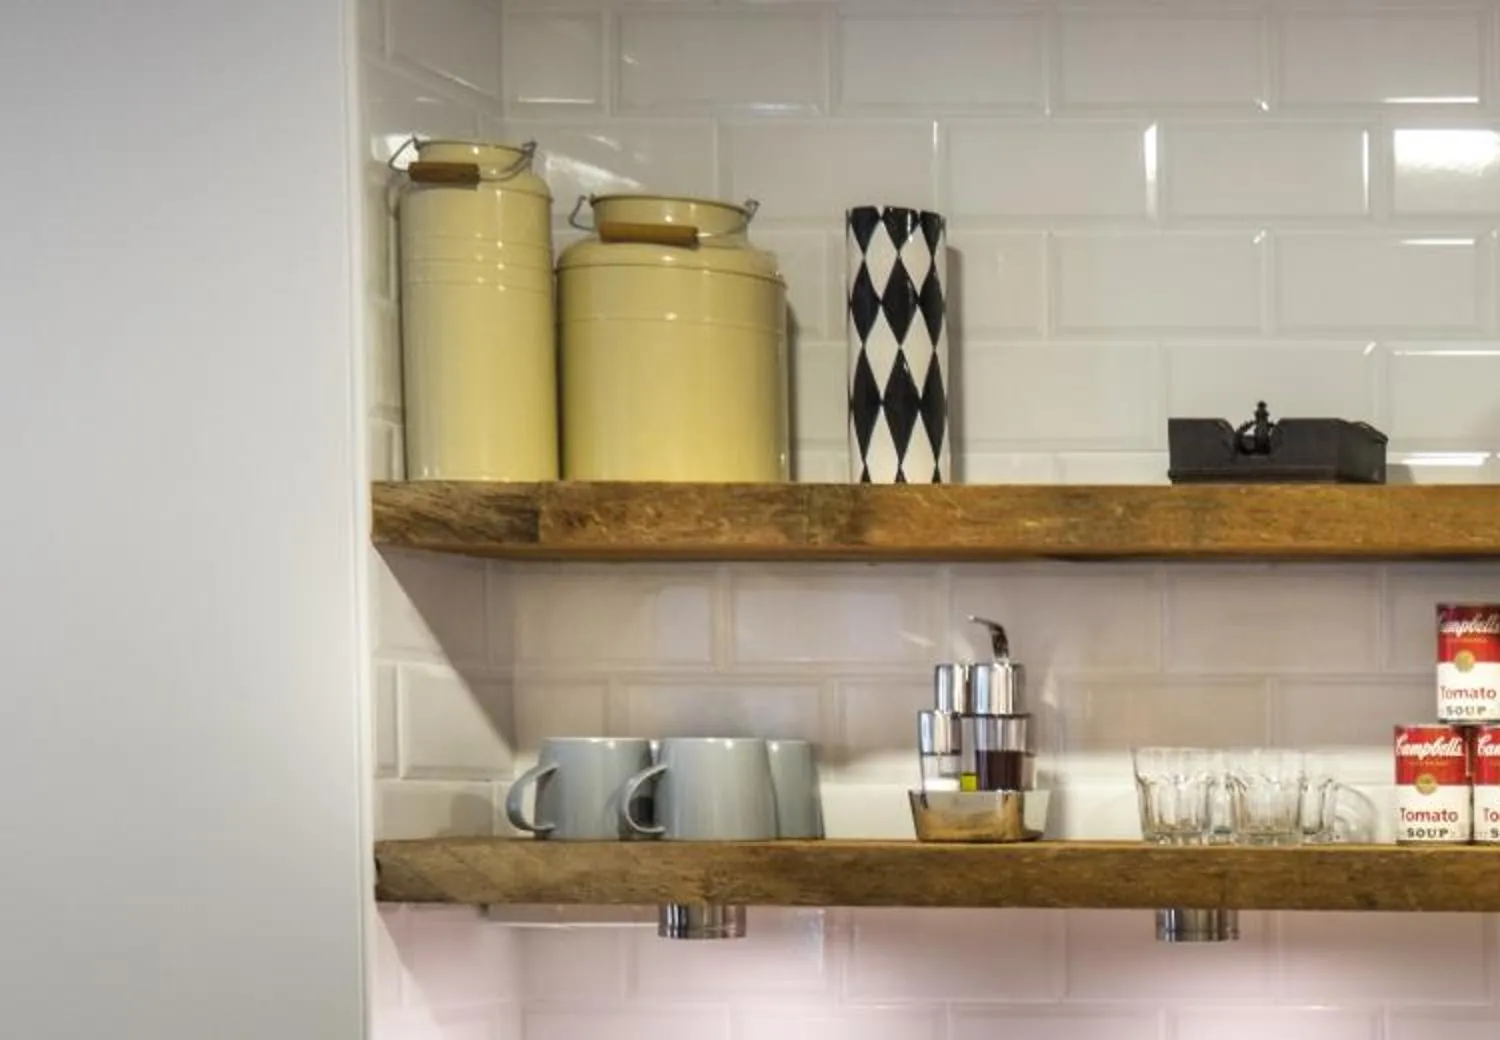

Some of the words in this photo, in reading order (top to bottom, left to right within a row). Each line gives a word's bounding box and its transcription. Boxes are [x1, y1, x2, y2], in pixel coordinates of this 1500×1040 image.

[1440, 685, 1497, 700] Tomato
[1445, 705, 1487, 716] SOUP
[1400, 808, 1459, 823] Tomato
[1407, 827, 1449, 839] SOUP
